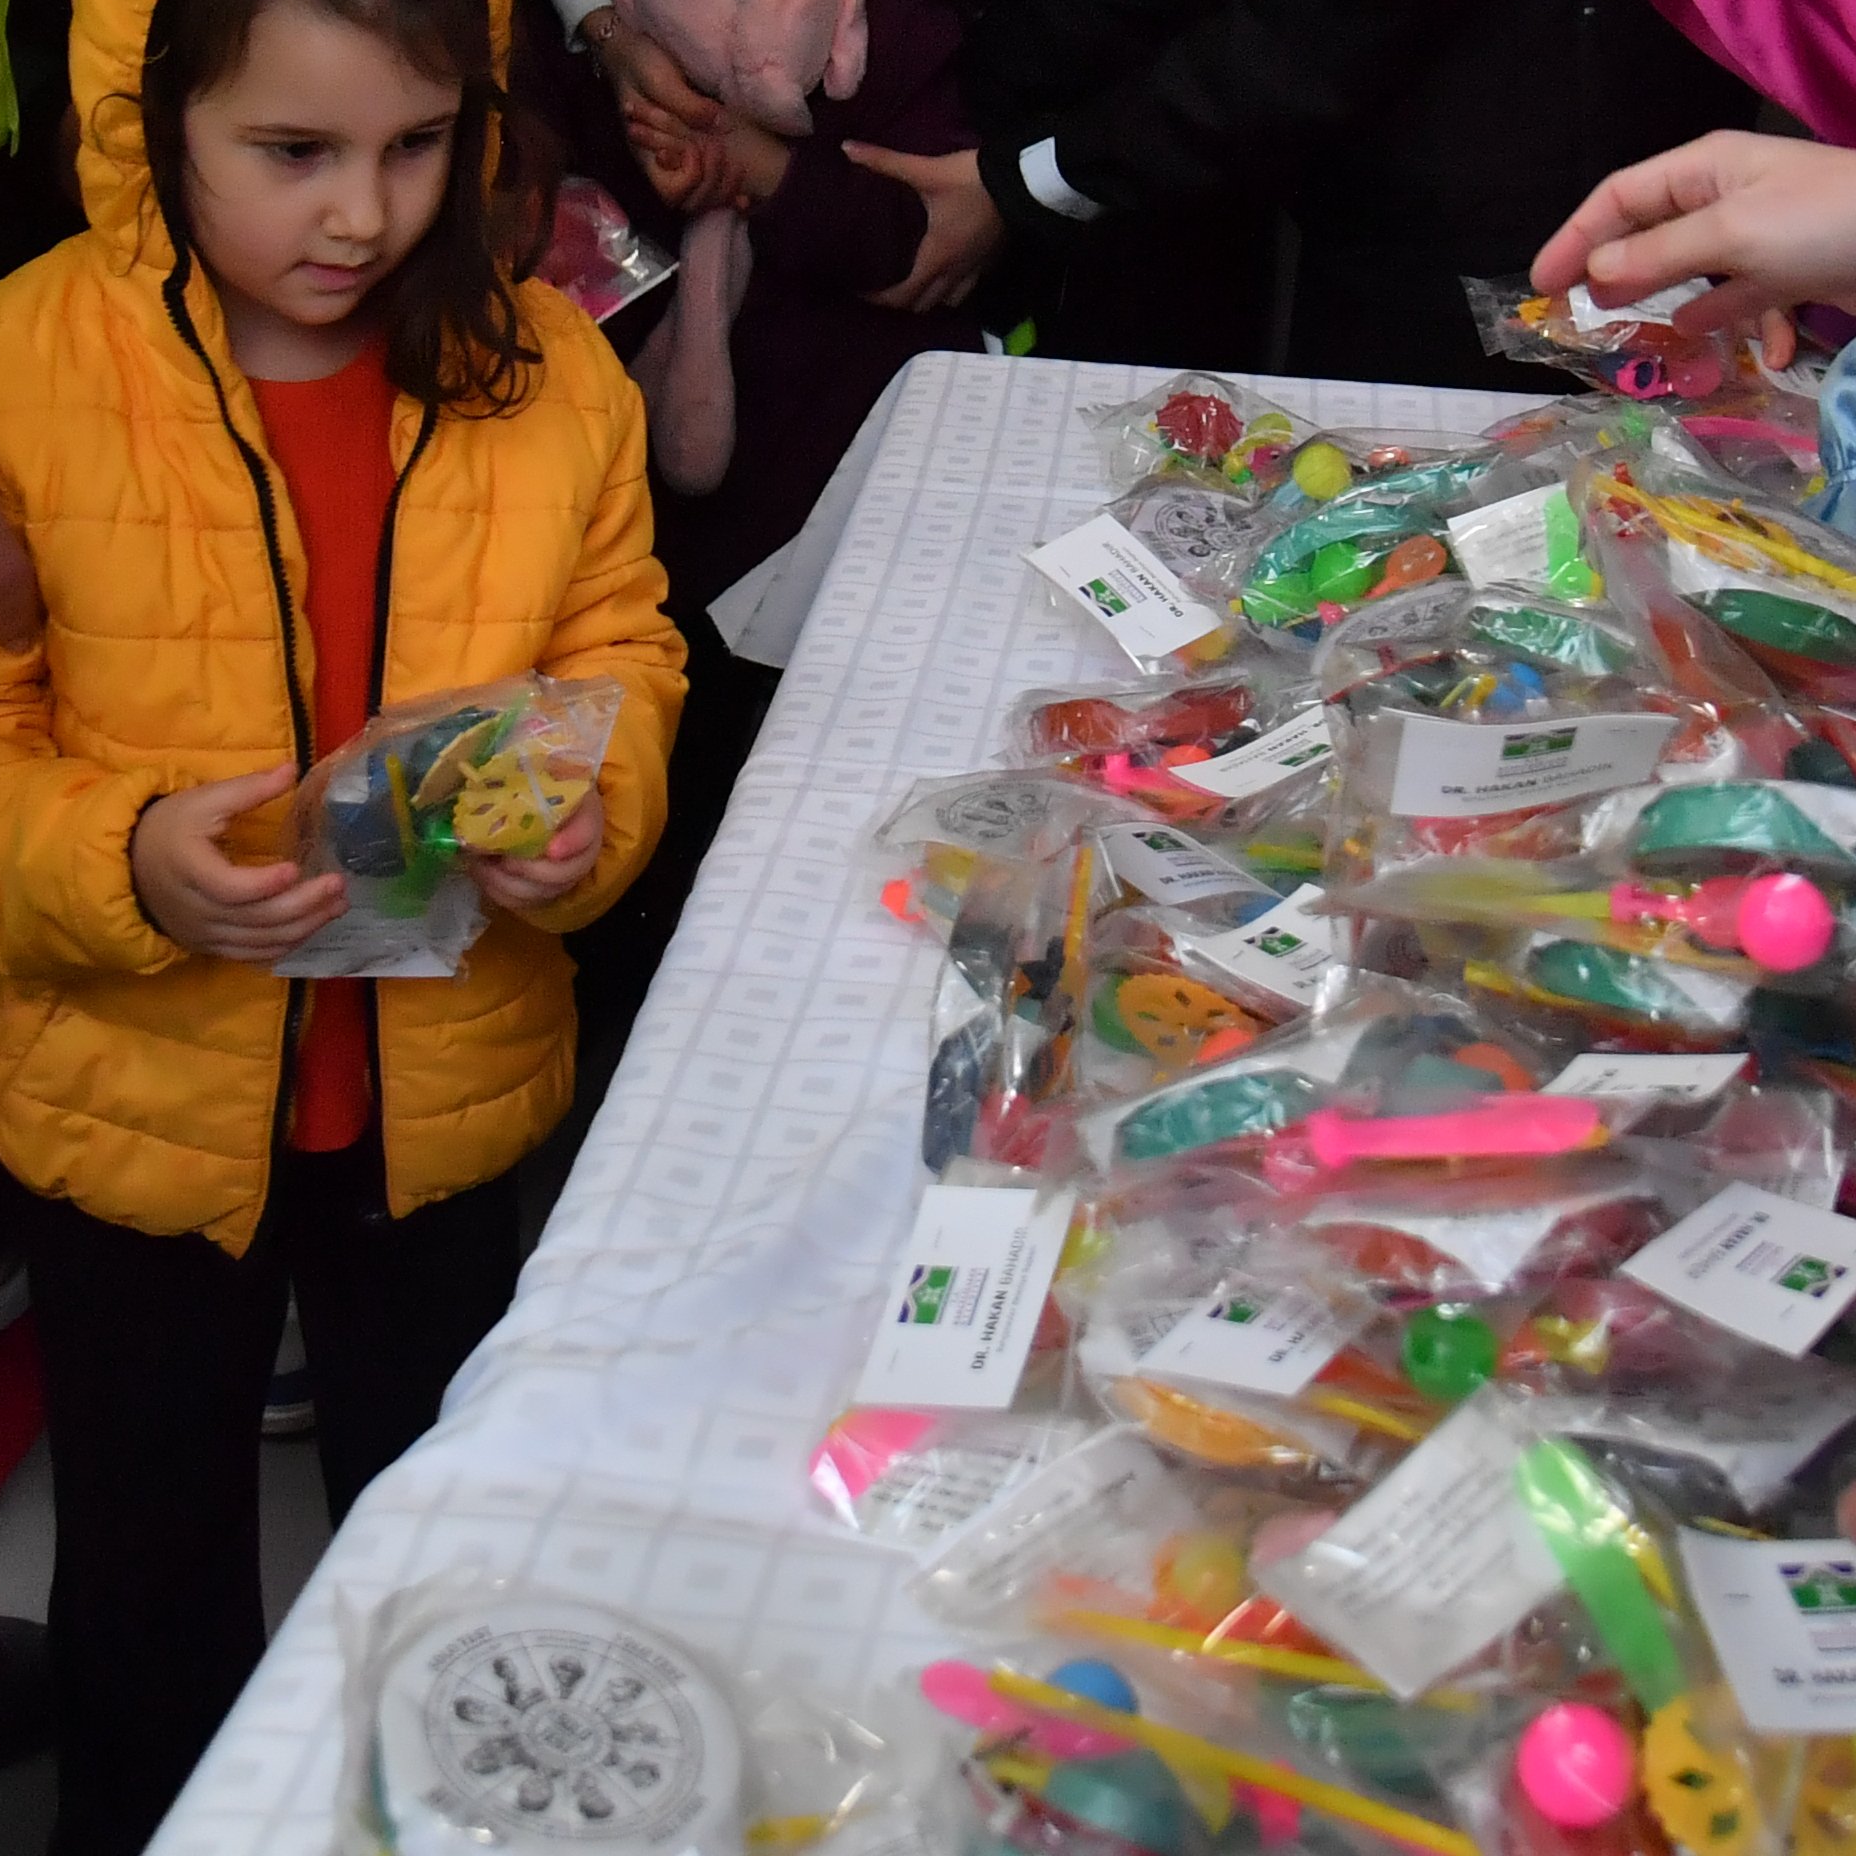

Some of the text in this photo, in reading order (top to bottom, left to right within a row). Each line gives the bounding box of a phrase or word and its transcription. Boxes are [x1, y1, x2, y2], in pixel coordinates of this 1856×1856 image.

[1136, 573, 1168, 603] HAKAN
[1475, 778, 1537, 794] HAKAN
[971, 1345, 991, 1370] DR.
[982, 1290, 1008, 1341] HAKAN
